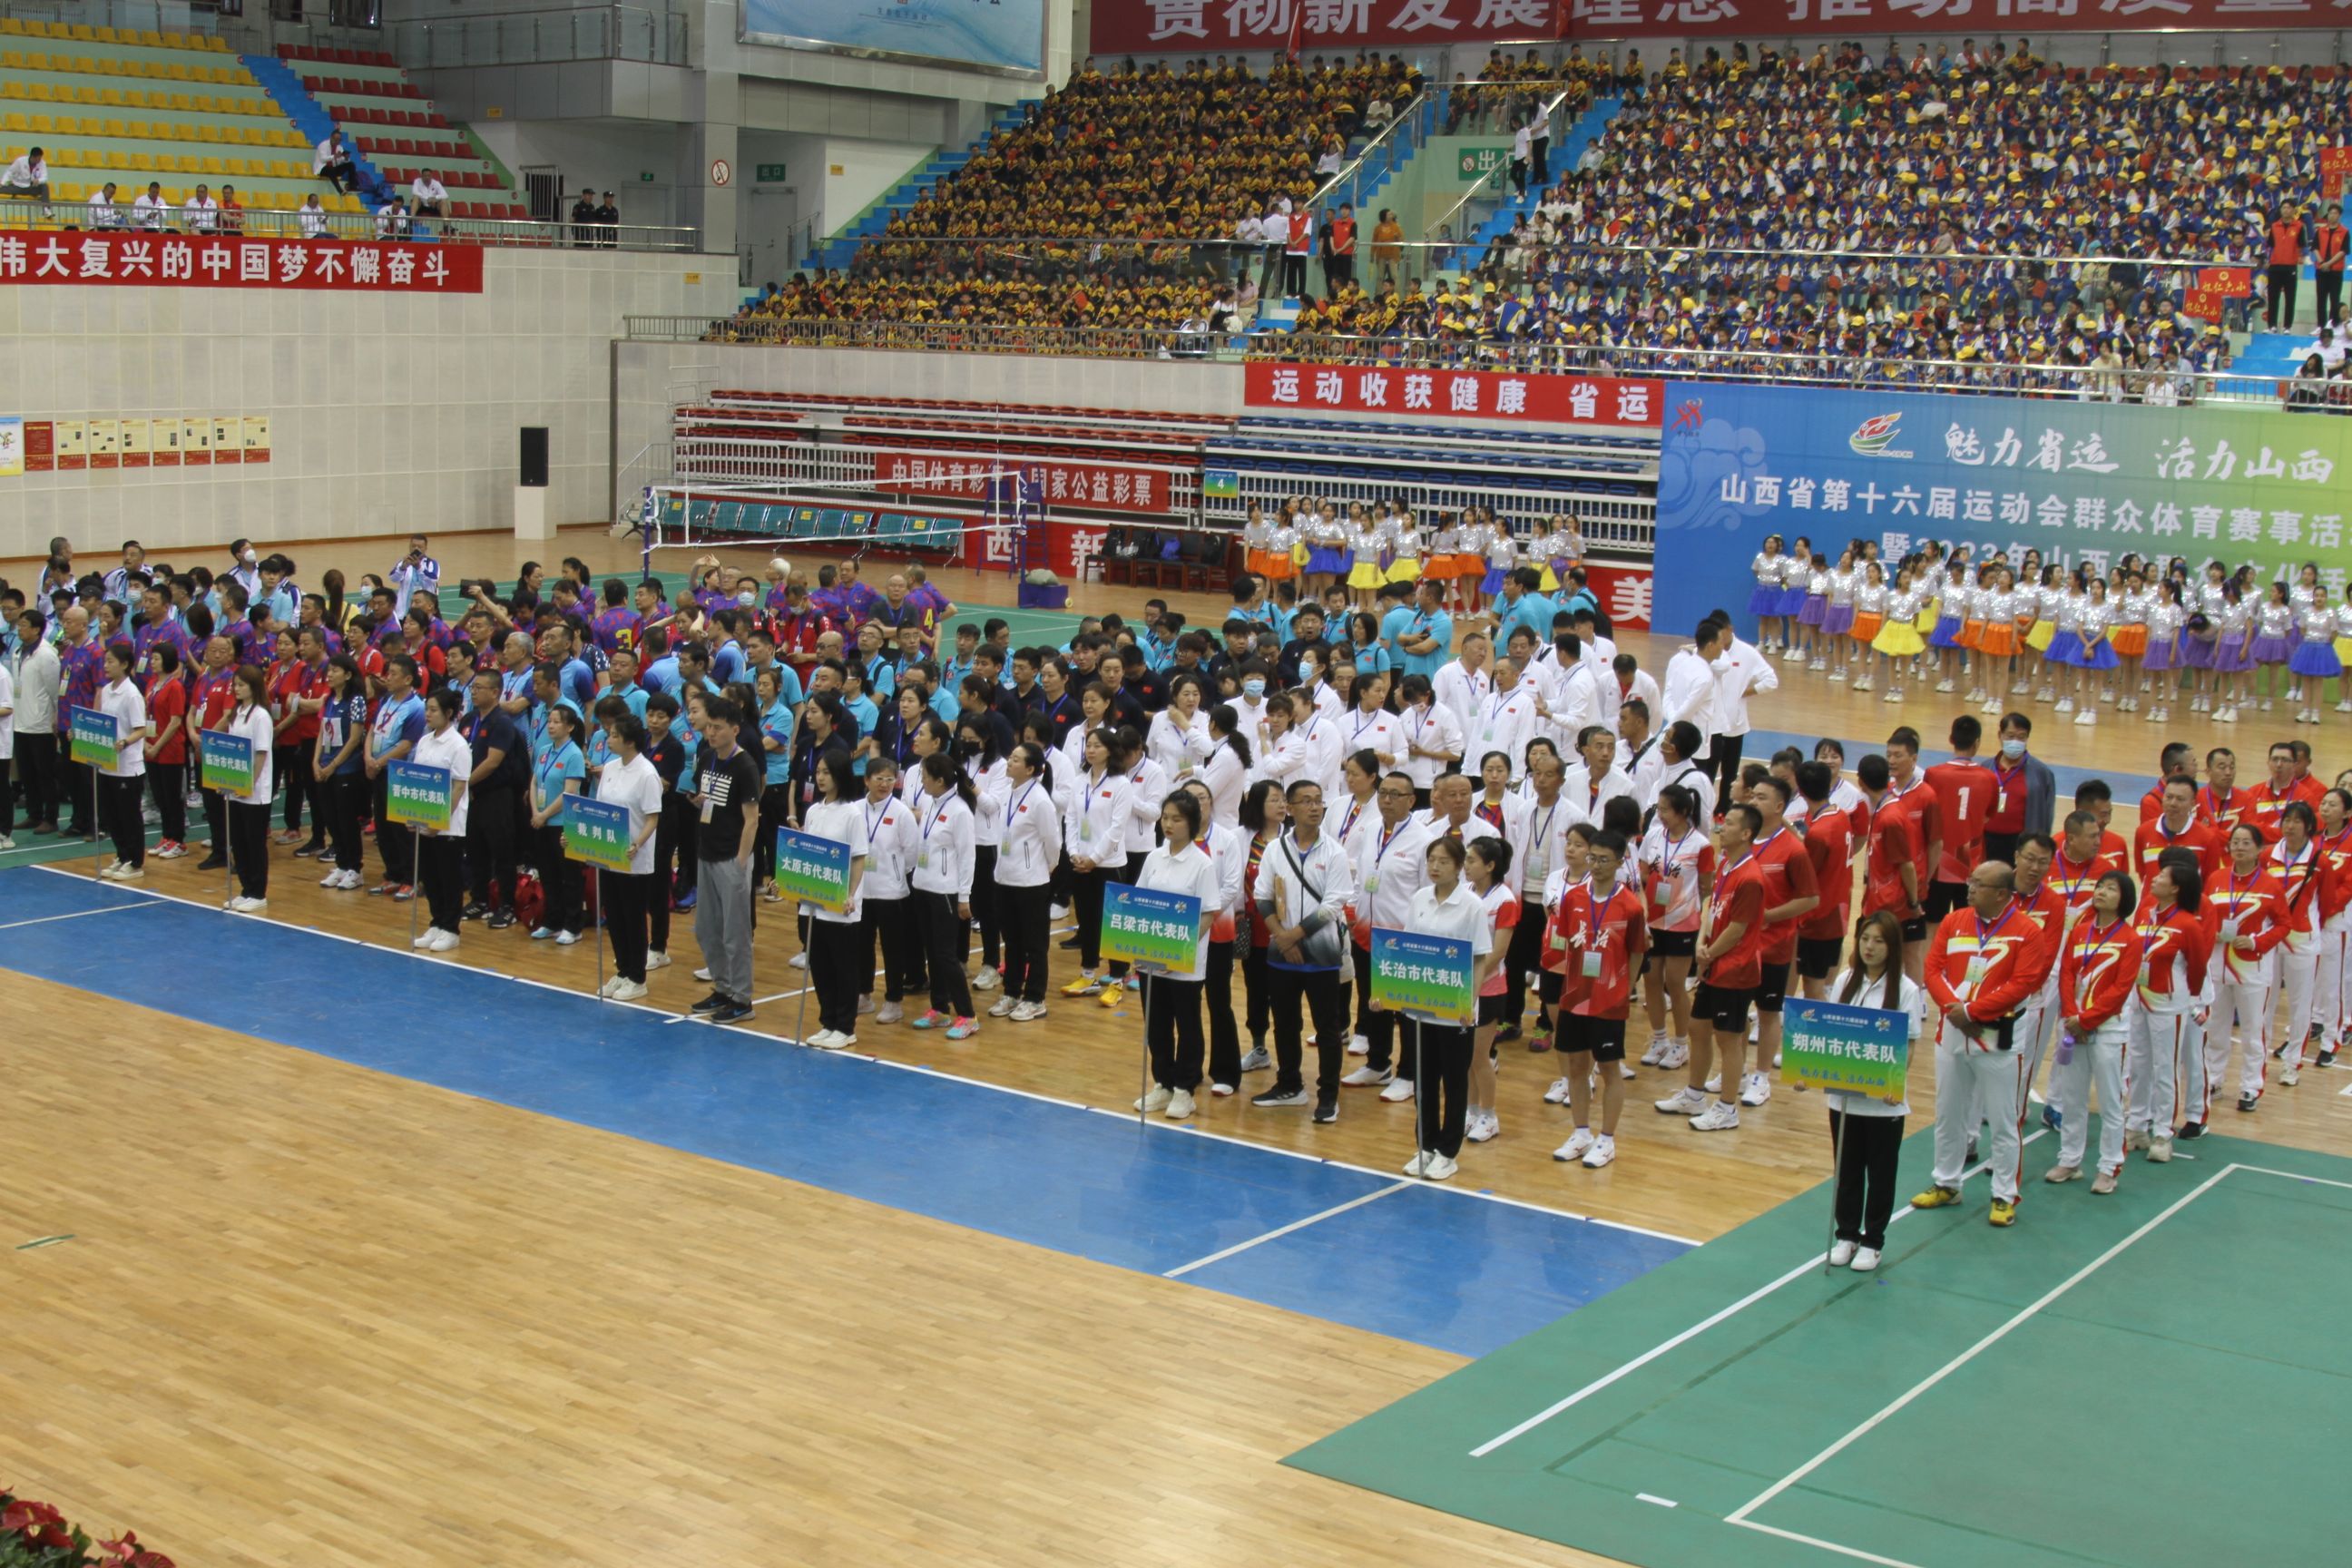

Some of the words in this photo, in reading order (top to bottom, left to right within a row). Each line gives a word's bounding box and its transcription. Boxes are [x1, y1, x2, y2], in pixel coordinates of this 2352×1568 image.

[0, 236, 450, 286] 伟大复兴的中国梦不懈奋斗
[1272, 369, 1525, 414] 运动收获健康
[1569, 383, 1649, 421] 省运
[1944, 421, 2120, 474] 魅力省运
[2154, 436, 2334, 485] 活力山西
[1217, 478, 1225, 490] 4
[1720, 473, 2352, 548] 山西省第十六届运动会群众体育赛事活
[1610, 576, 1652, 622] 美
[924, 608, 935, 631] 4
[392, 783, 446, 806] 晋中市代表队
[1958, 787, 1970, 820] 1
[577, 821, 617, 844] 裁判队
[781, 856, 843, 885] 太原市代表队
[1110, 913, 1191, 942] 吕梁市代表队
[1378, 959, 1465, 988] 长治市代表队
[1791, 1033, 1897, 1064] 朔州市代表队
